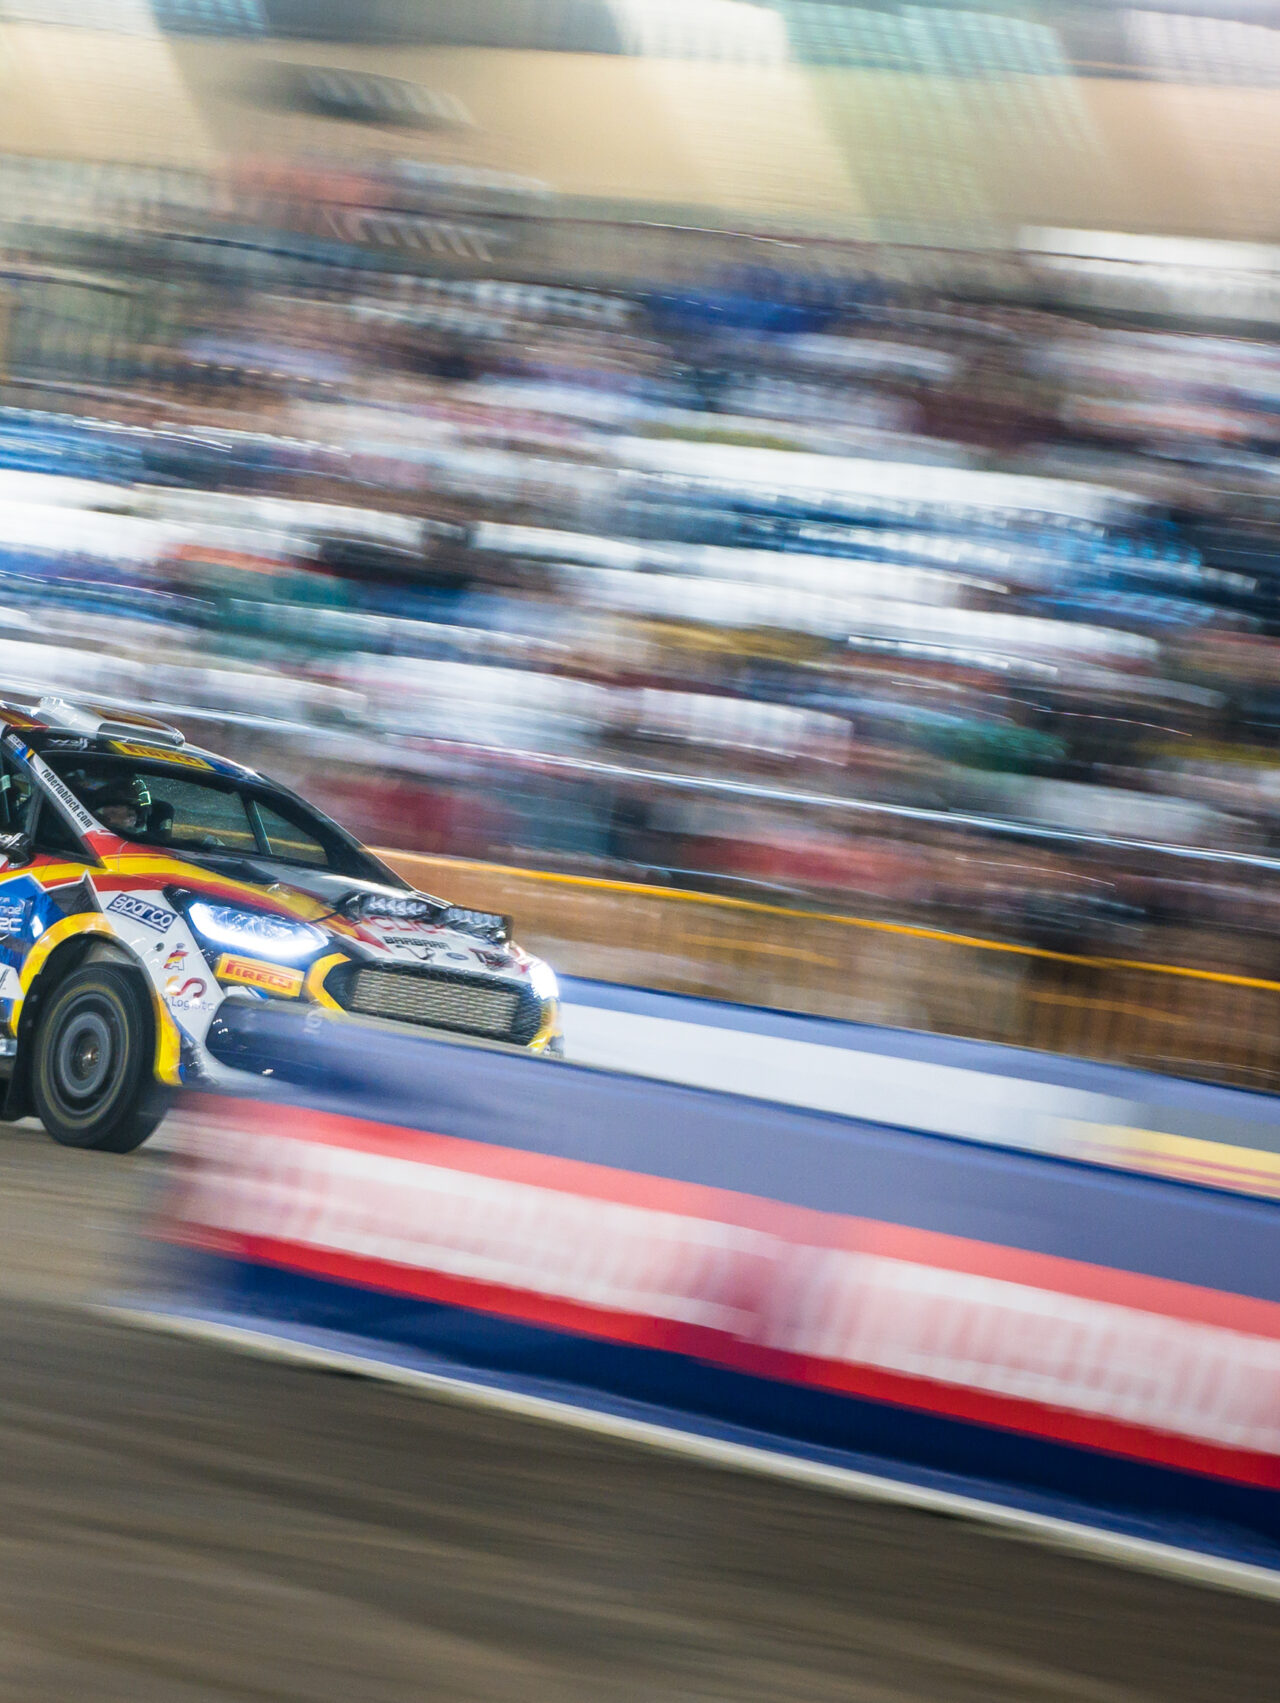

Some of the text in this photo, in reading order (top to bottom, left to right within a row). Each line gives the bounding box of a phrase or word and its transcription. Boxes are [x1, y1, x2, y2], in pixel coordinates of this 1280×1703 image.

[41, 768, 93, 829] robertoblach.com
[113, 894, 173, 928] sparco
[225, 959, 294, 990] PIRELLI
